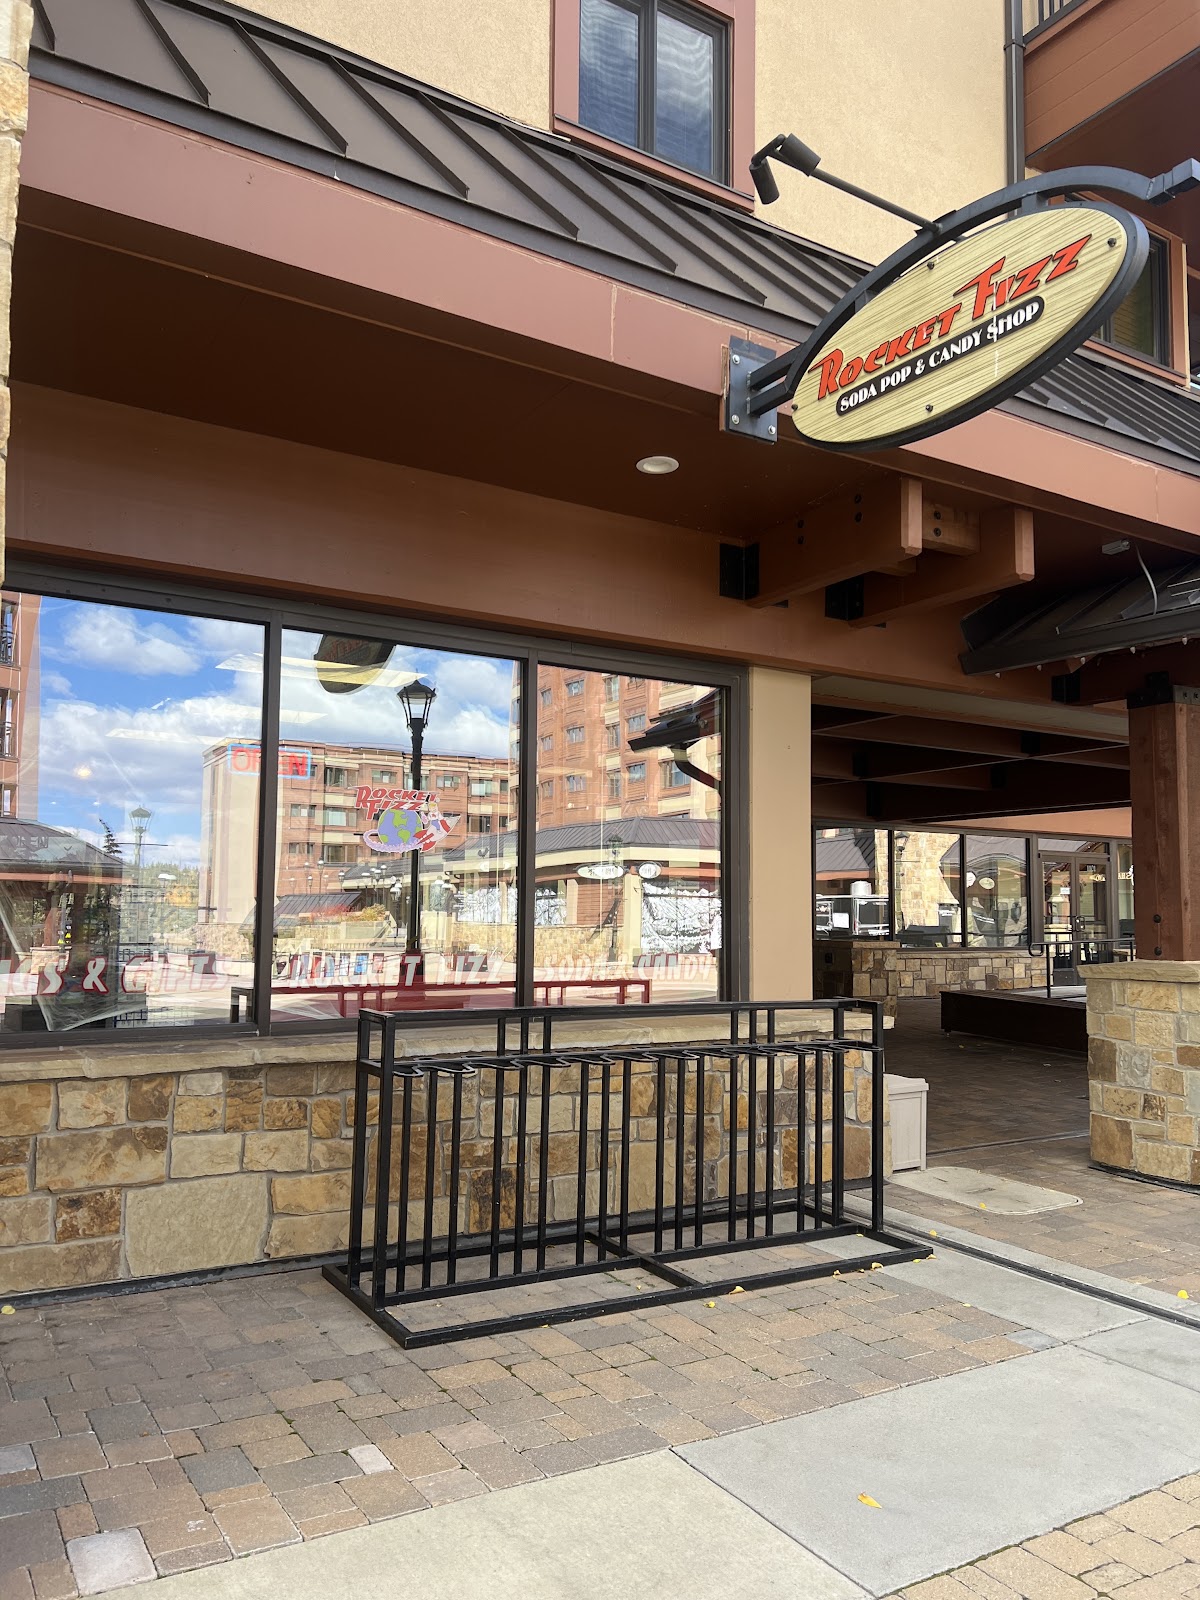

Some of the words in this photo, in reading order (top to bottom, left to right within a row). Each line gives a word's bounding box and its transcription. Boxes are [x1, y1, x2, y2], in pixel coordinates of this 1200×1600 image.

[808, 303, 962, 400] ROCKET
[953, 234, 1093, 320] FIZZ
[839, 385, 877, 412] SODA
[880, 366, 911, 390] POP
[914, 358, 926, 376] &
[928, 329, 982, 368] CANDY
[986, 301, 1040, 341] SHOP
[350, 786, 440, 808] ROCKET
[364, 799, 424, 820] FIZZ
[82, 956, 109, 995] &
[121, 953, 232, 993] GIFTS
[542, 953, 609, 981] SODA
[636, 952, 715, 981] CANDY
